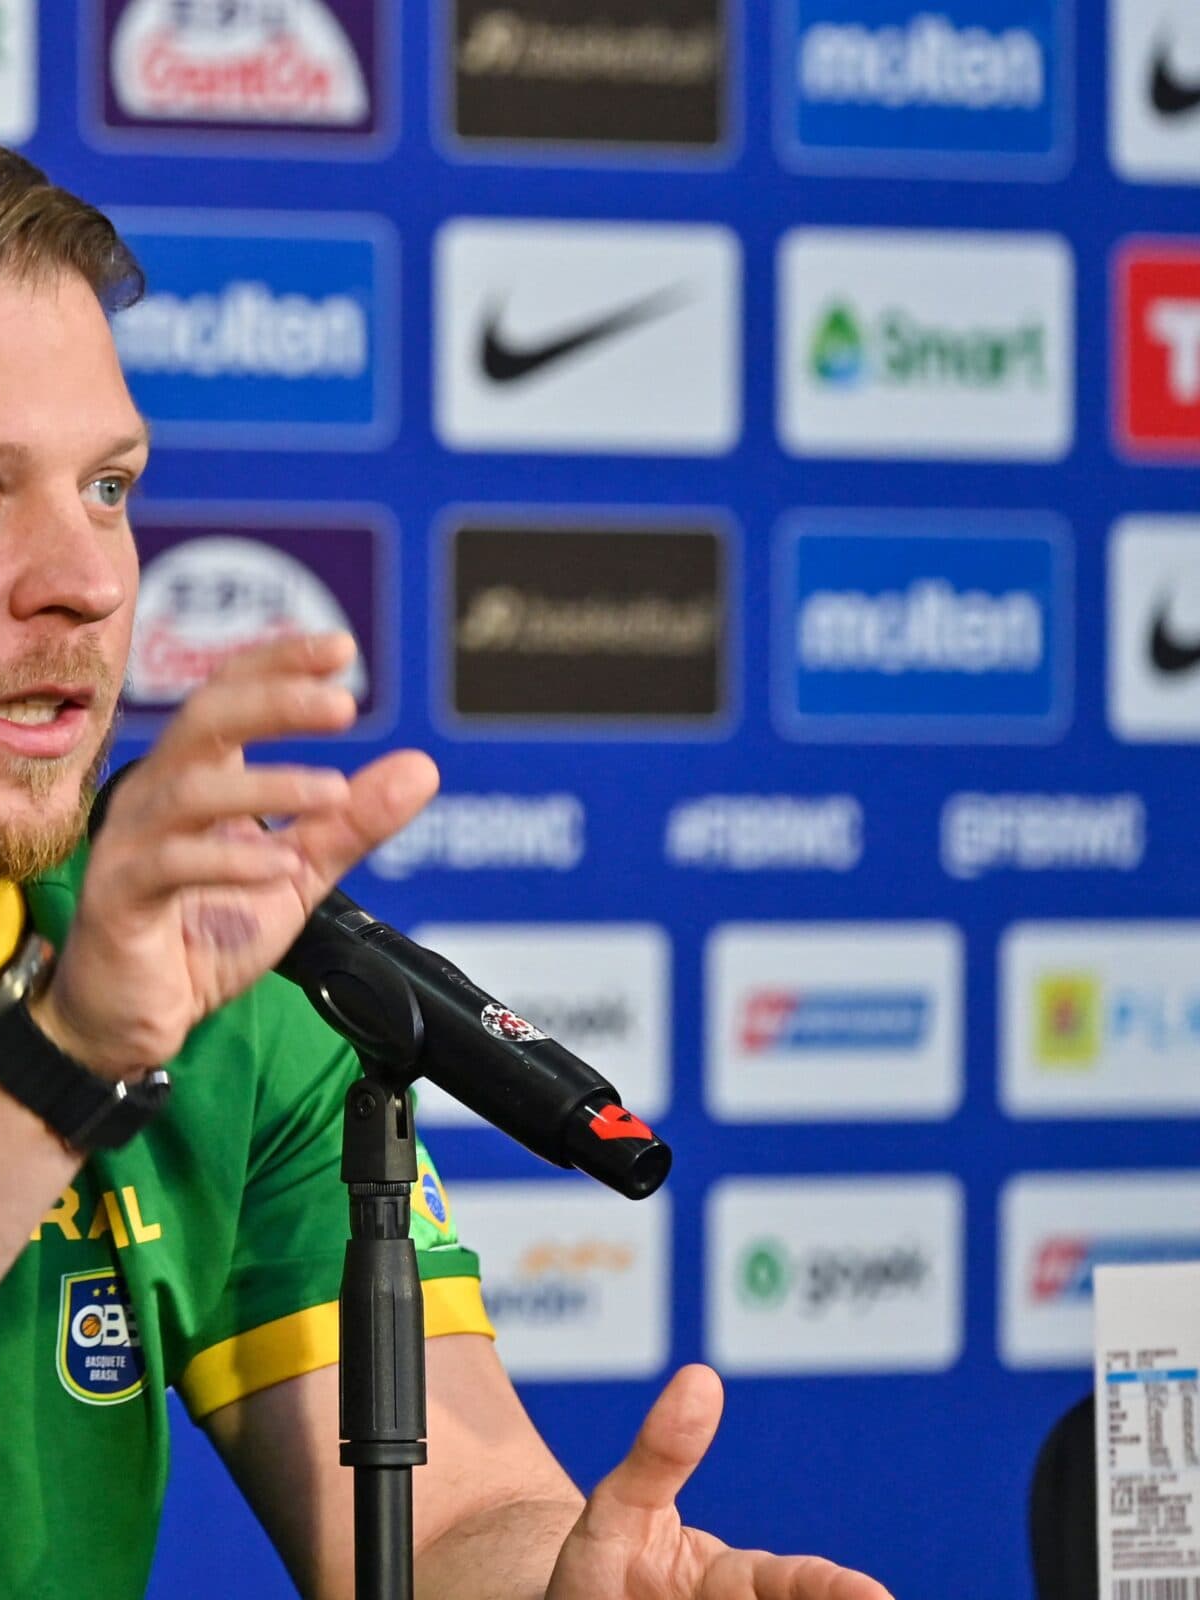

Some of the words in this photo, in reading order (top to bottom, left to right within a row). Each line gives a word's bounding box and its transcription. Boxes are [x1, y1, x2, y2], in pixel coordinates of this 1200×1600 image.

[884, 308, 1046, 388] Smart
[84, 1355, 127, 1369] BASQUETE
[89, 1369, 119, 1381] BRASIL
